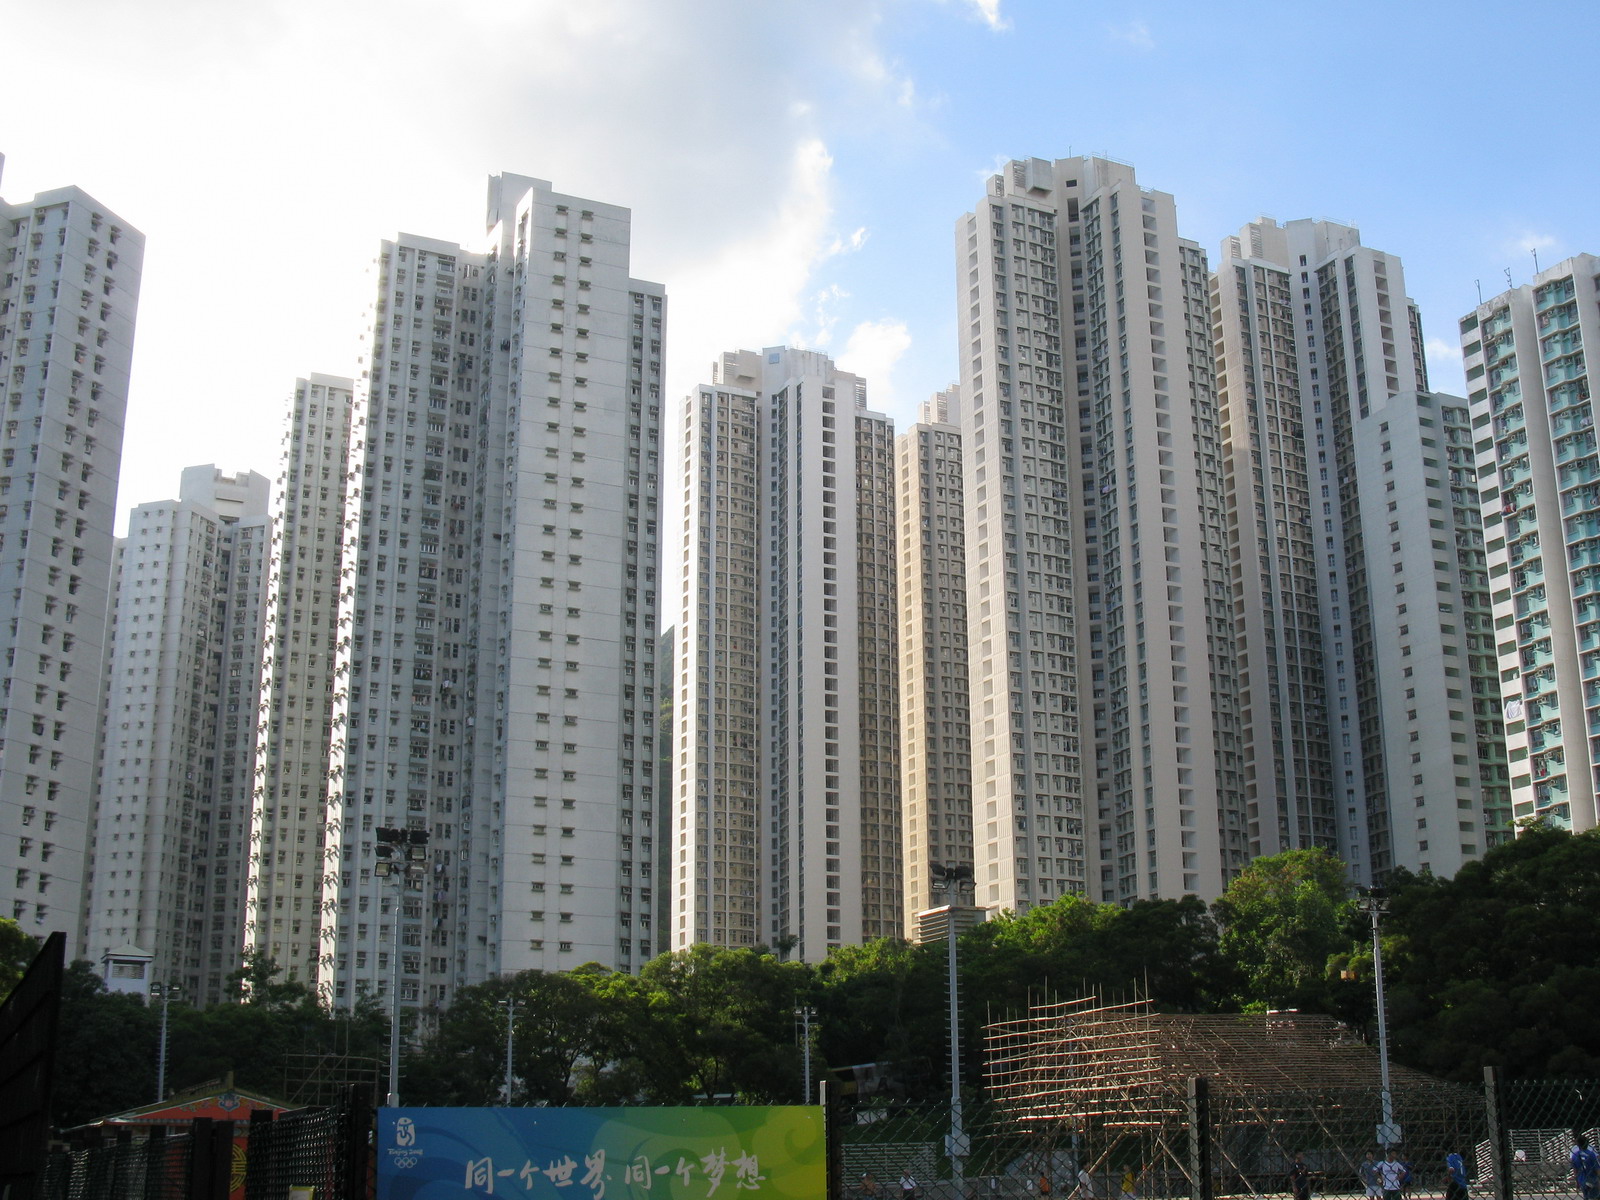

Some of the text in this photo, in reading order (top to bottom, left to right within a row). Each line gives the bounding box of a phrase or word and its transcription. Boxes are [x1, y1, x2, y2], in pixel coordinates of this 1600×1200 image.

[465, 1147, 767, 1200] 同一个世界 同一个梦想
